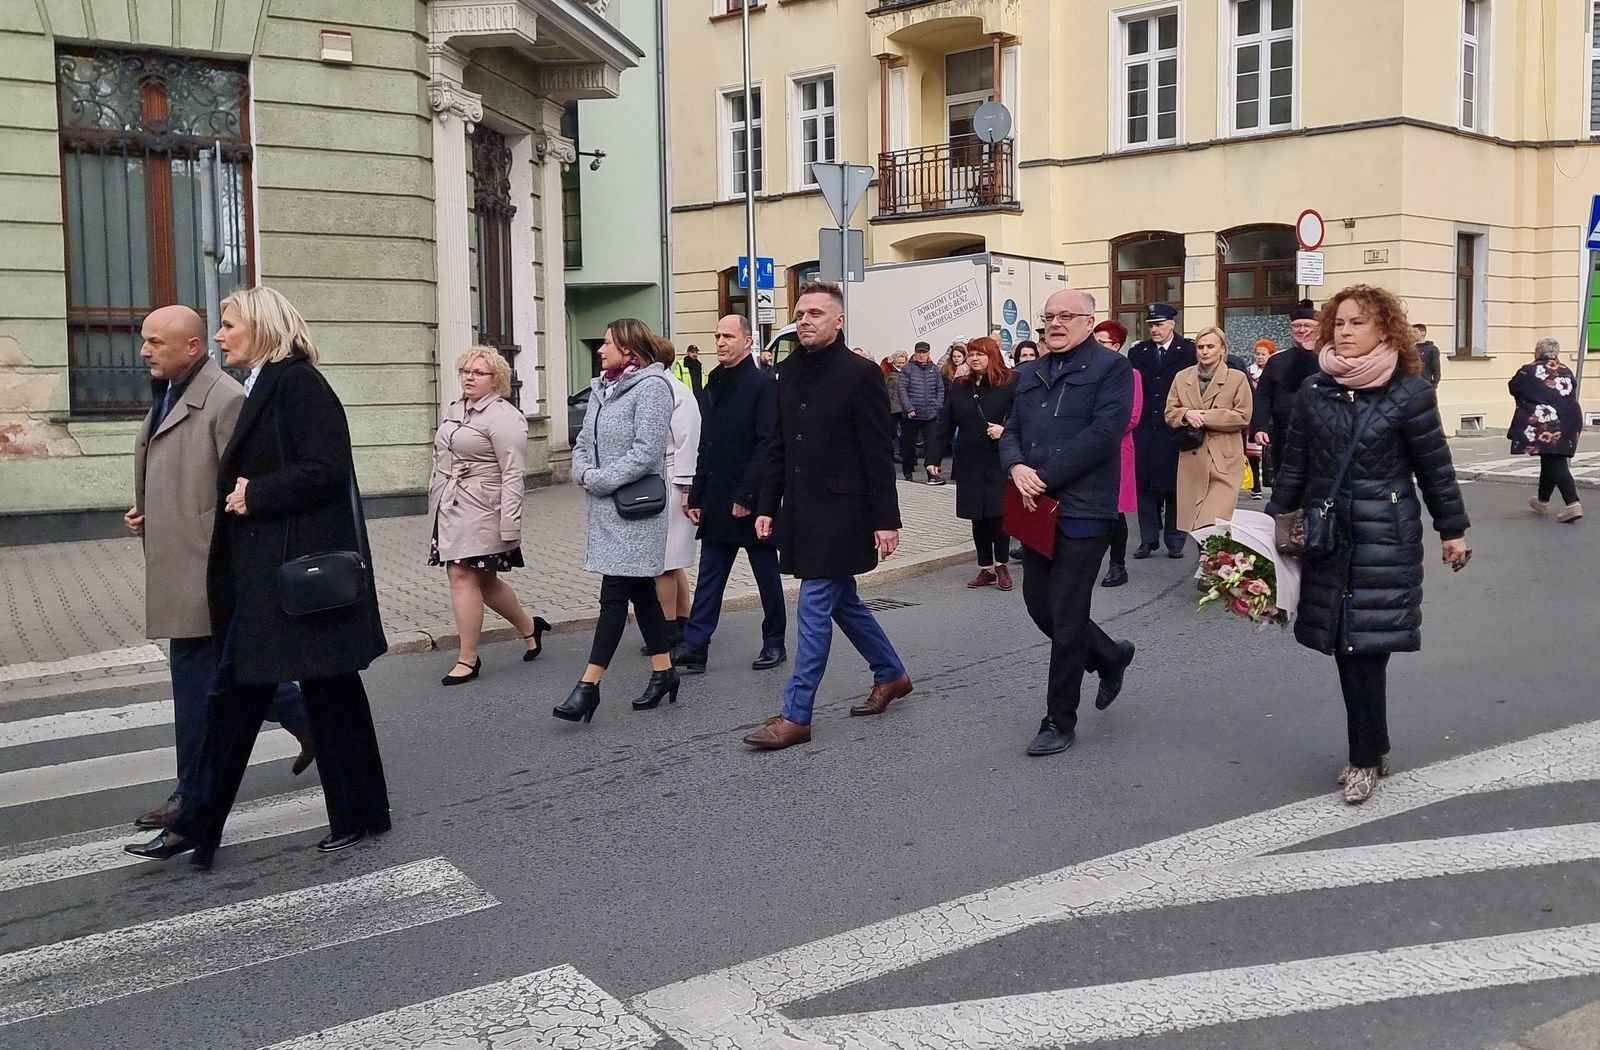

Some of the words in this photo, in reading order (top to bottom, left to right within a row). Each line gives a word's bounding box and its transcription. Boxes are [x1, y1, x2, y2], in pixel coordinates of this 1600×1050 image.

[917, 294, 947, 316] DOWOZIMY
[947, 284, 968, 301] CZĘŚCI
[918, 324, 927, 334] DO
[953, 298, 978, 316] SERWISU
[923, 294, 968, 321] MERCEDES-BENZ
